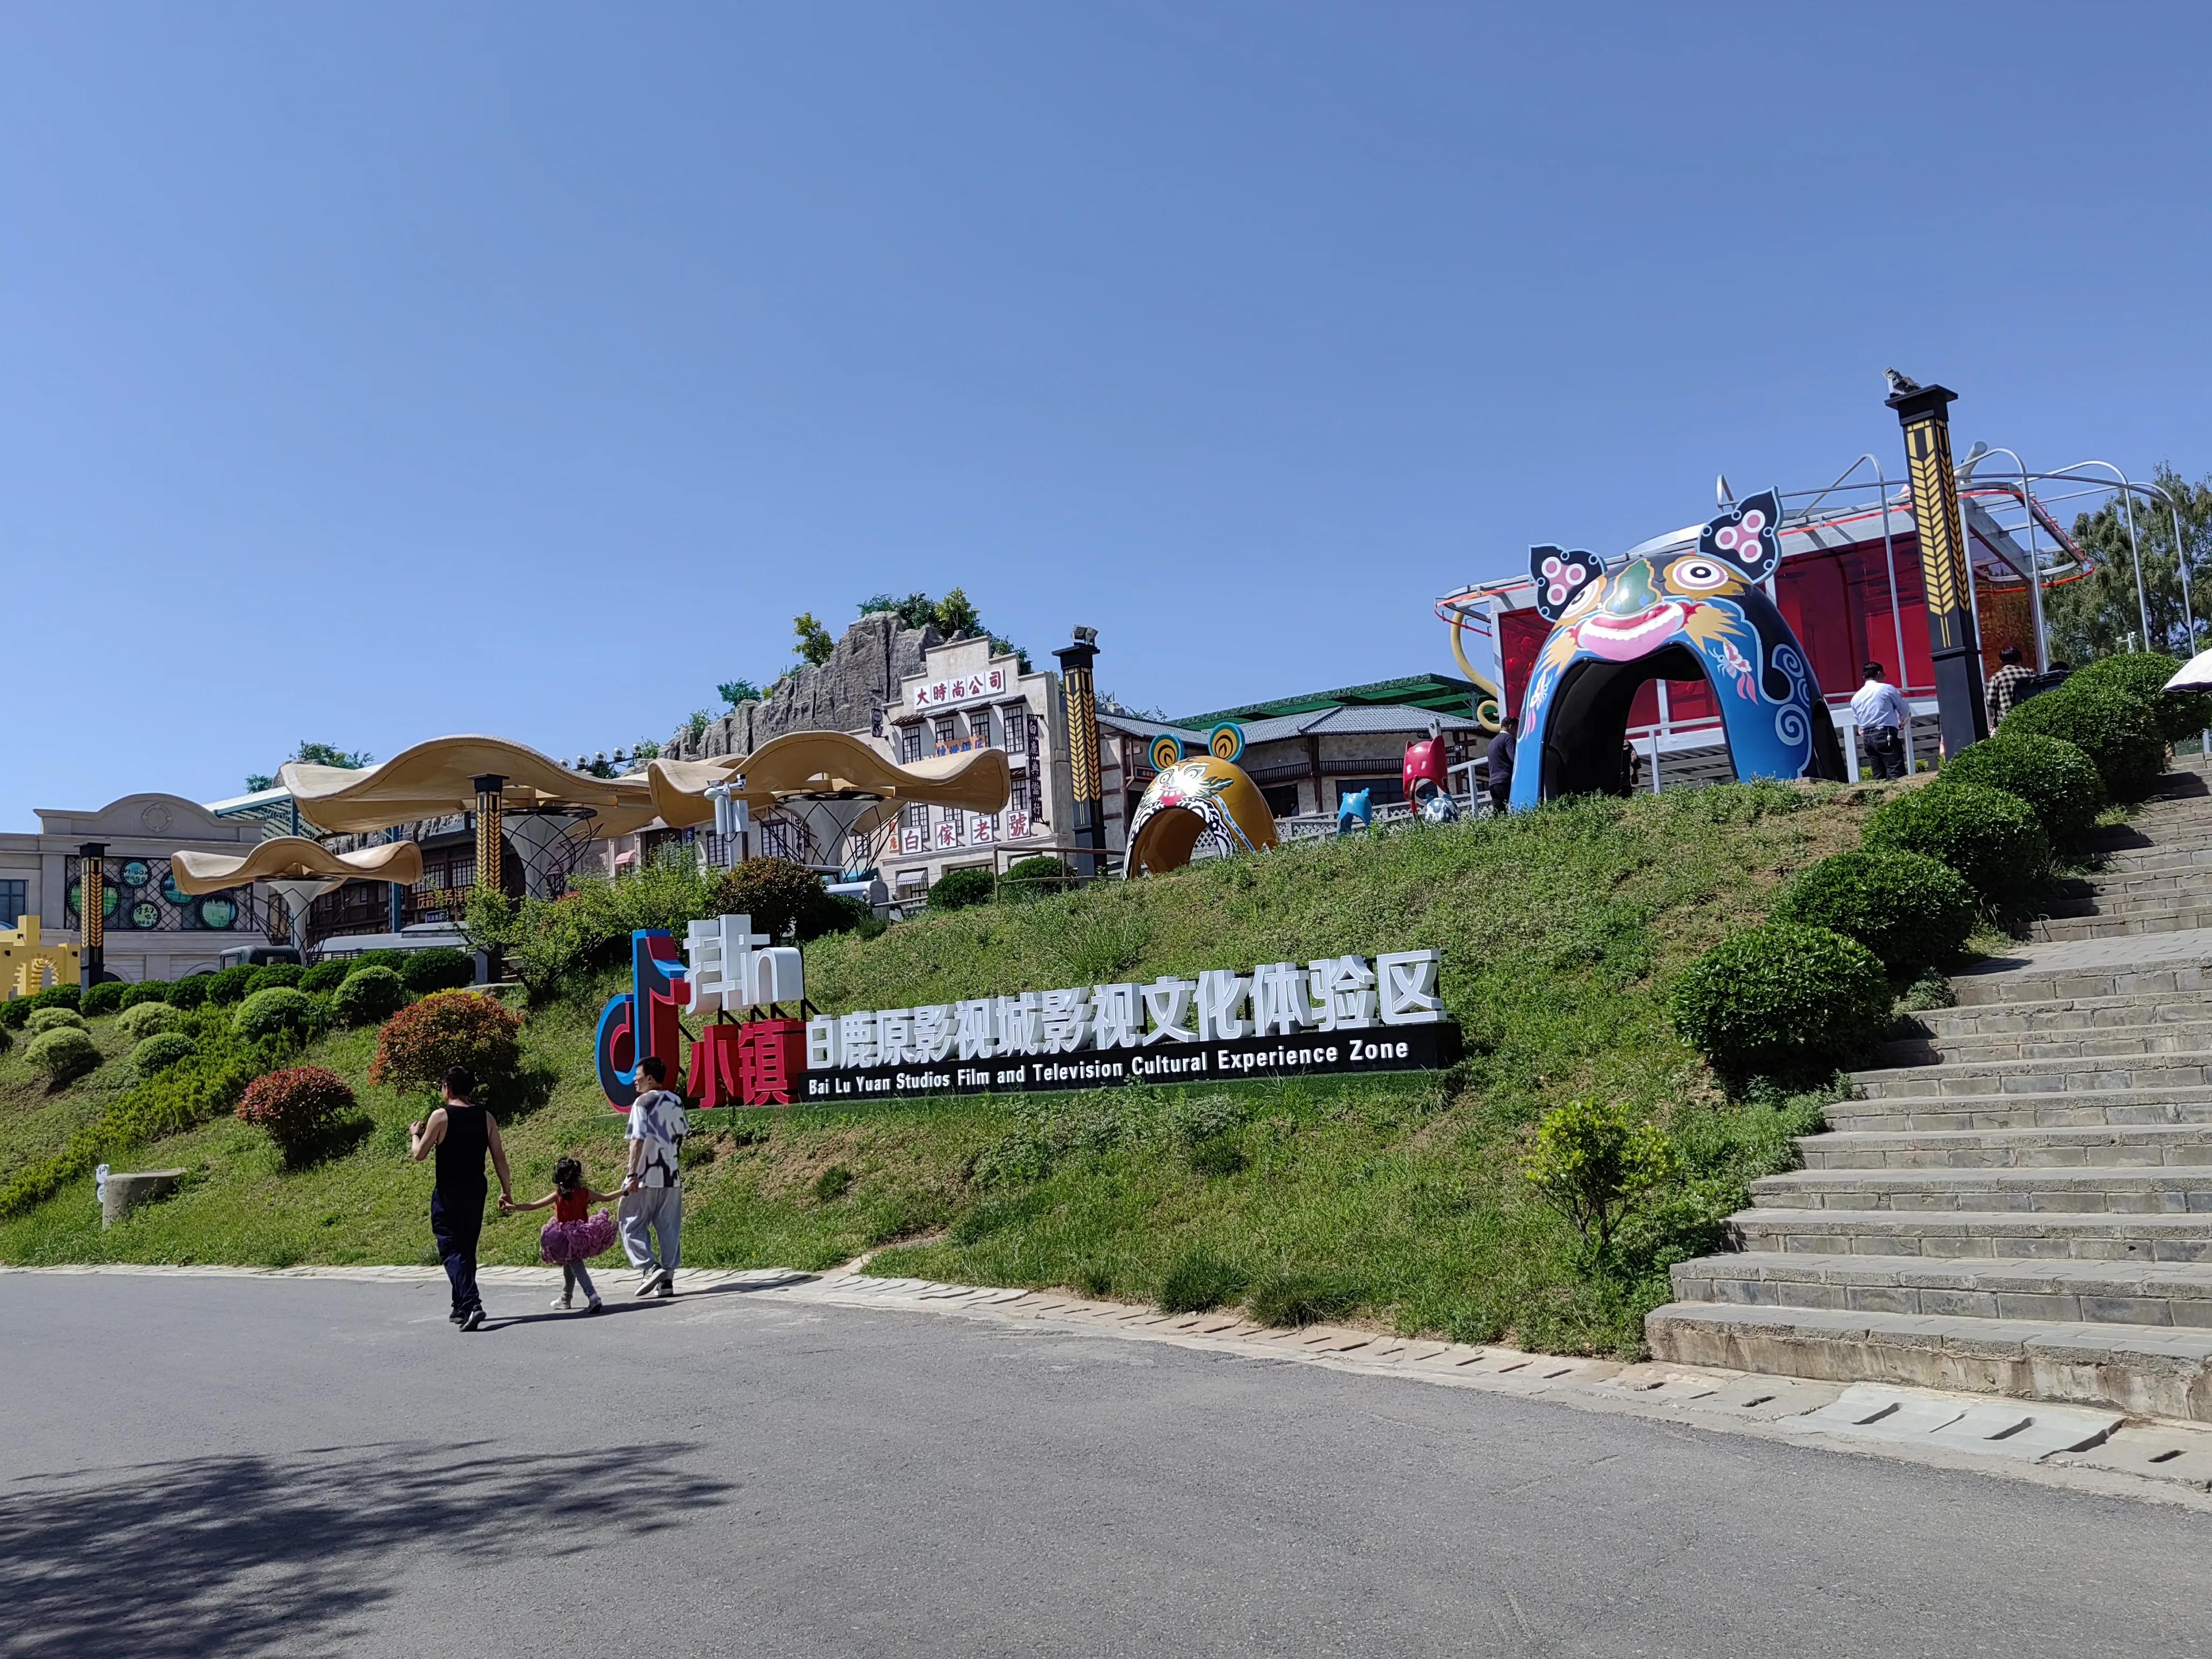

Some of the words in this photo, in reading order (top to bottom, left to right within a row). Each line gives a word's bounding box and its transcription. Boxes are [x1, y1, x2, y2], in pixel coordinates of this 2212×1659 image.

[916, 671, 1002, 706] 大時尚公司
[1029, 721, 1041, 815] 白鹿典當行
[905, 812, 1029, 851] 白傢老號
[806, 949, 1446, 1069] 白鹿原影视城影视文化体验区
[687, 1018, 798, 1108] 小镇
[809, 1077, 830, 1095] Bai
[835, 1077, 851, 1092] Lu
[857, 1076, 889, 1091] Yuan
[896, 1071, 950, 1090] Studios
[958, 1068, 990, 1085] Film
[997, 1065, 1025, 1083] and
[1033, 1060, 1123, 1081] Television
[1132, 1052, 1208, 1075] Cultural
[1218, 1046, 1338, 1072] Experience
[1350, 1039, 1409, 1061] Zone
